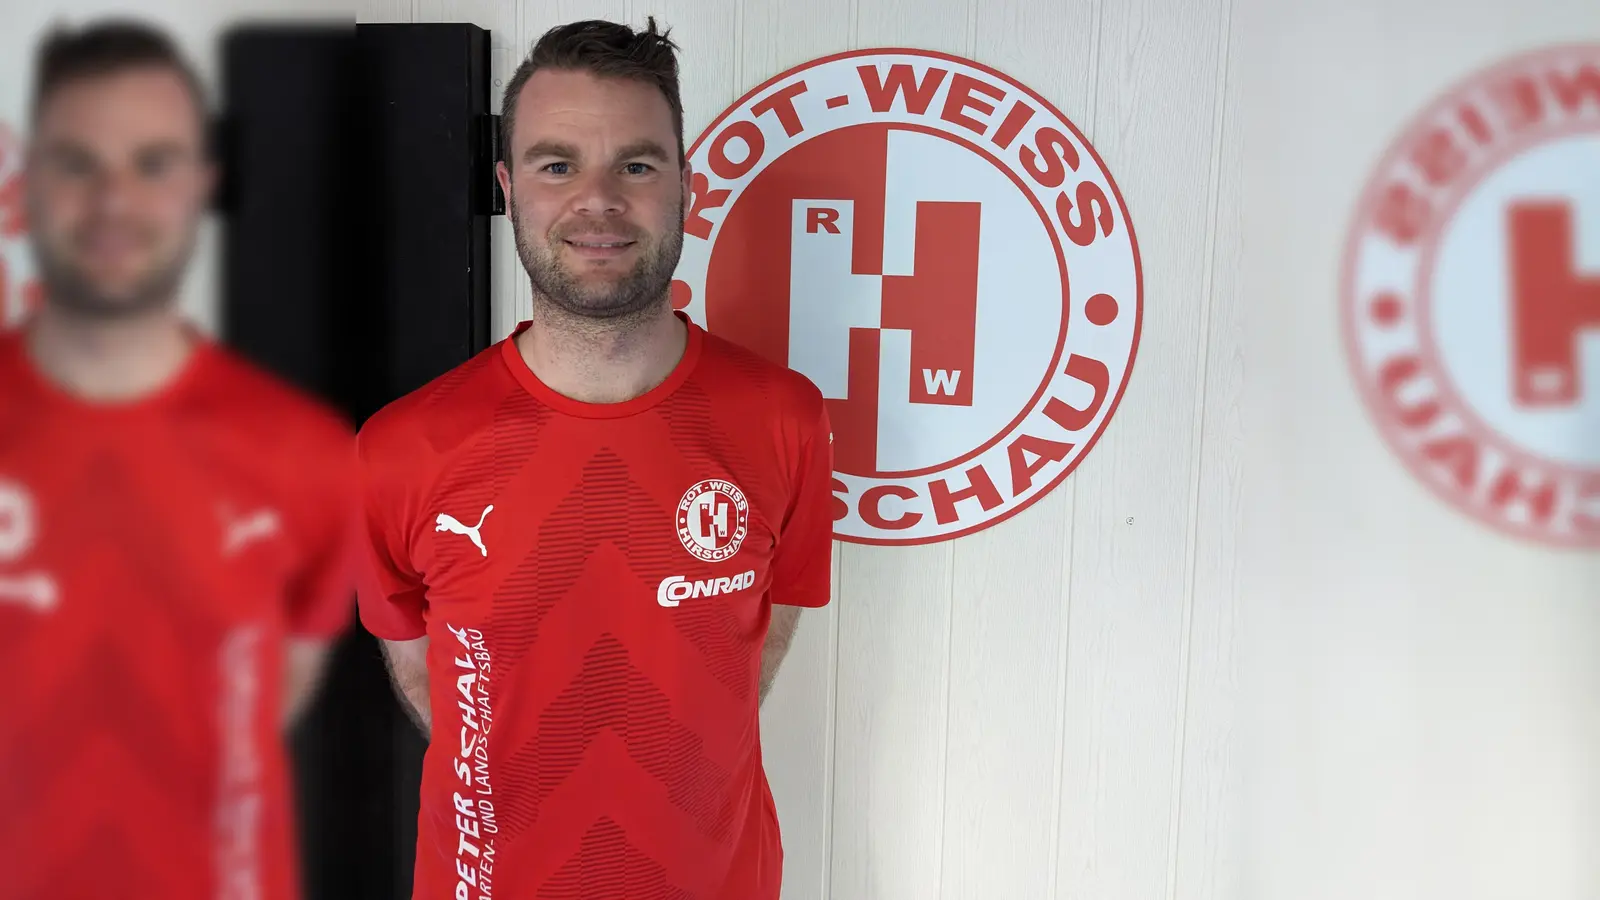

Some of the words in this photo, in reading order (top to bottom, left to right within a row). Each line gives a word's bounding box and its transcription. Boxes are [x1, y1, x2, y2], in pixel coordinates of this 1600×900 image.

[683, 63, 1115, 247] ROT-WEISS
[806, 207, 841, 234] R
[922, 368, 962, 396] W
[831, 353, 1111, 531] CHAU
[680, 481, 746, 511] ROT-WEISS
[679, 526, 746, 560] HIRSCHAU
[656, 569, 756, 608] CONRAD
[467, 628, 493, 795] LANDSCHAFTSBAU
[478, 799, 499, 834] UND
[453, 791, 481, 900] PETER
